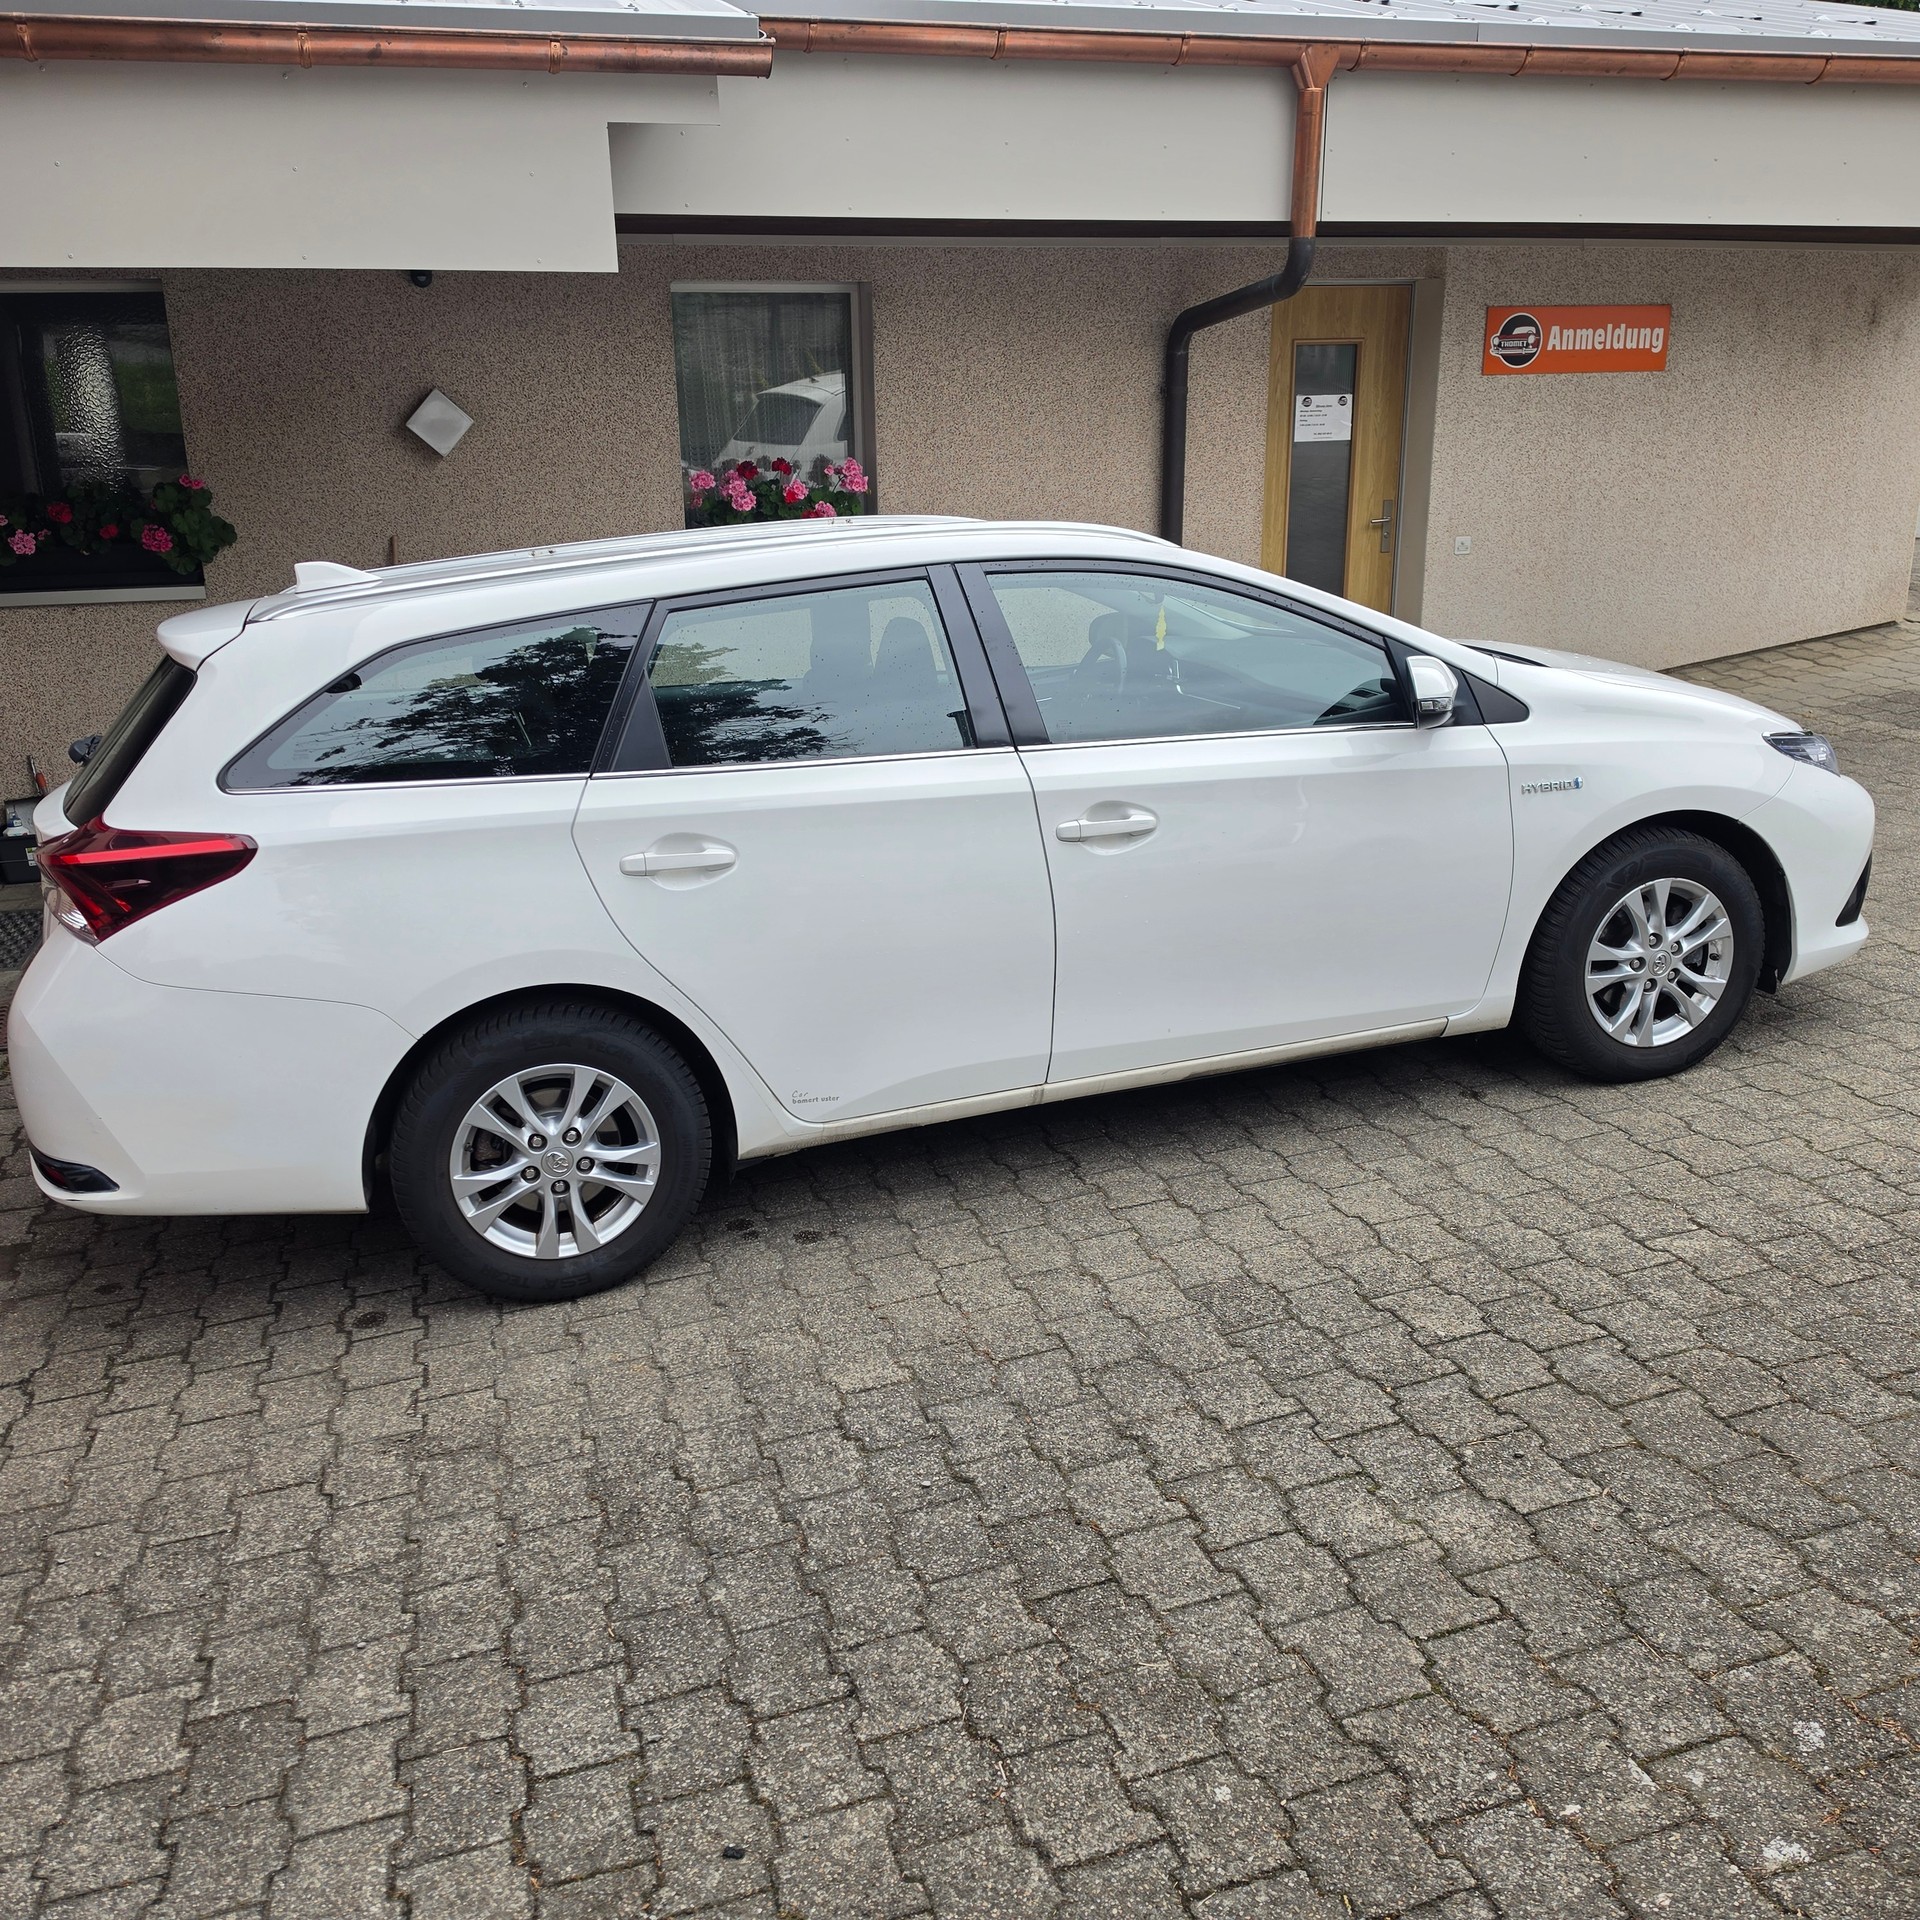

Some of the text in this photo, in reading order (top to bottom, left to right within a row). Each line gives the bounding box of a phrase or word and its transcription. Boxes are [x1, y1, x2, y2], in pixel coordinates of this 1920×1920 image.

[1501, 340, 1528, 348] THOMET
[1547, 324, 1665, 353] Anmeldung
[1521, 780, 1574, 795] HYBRID
